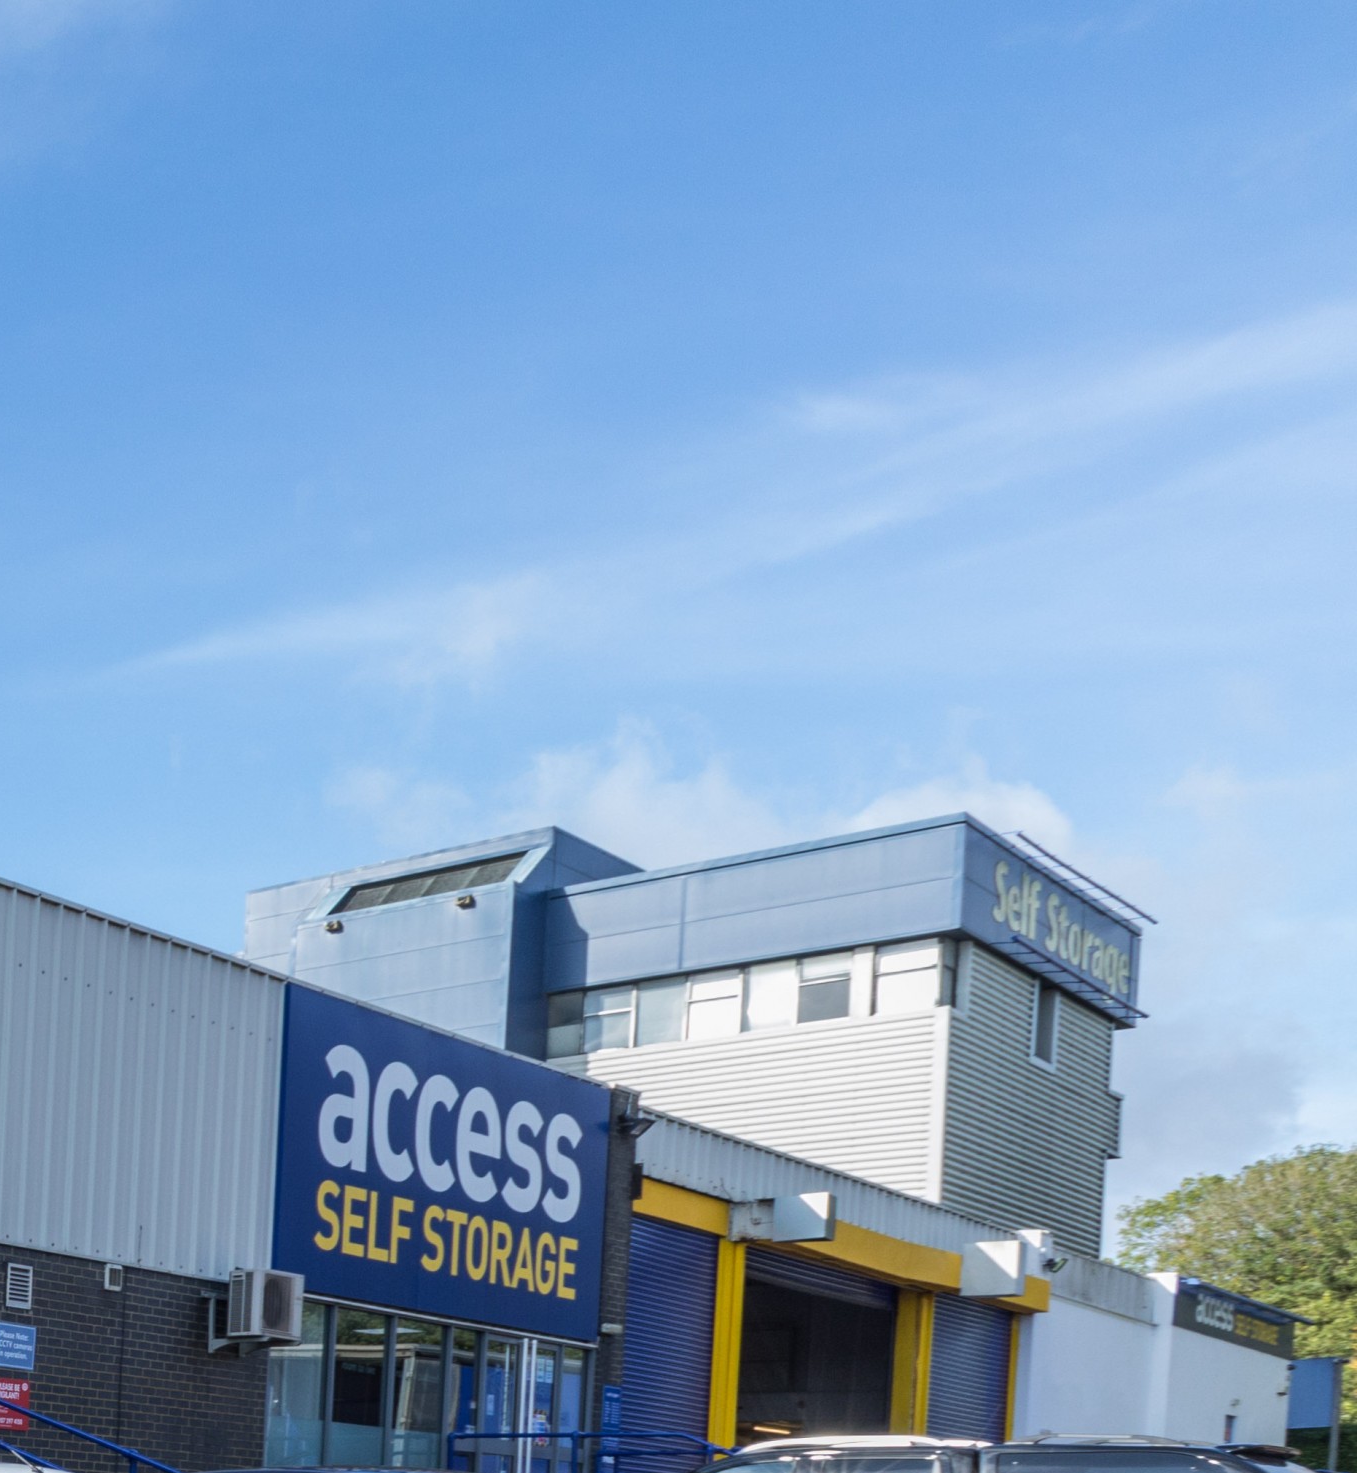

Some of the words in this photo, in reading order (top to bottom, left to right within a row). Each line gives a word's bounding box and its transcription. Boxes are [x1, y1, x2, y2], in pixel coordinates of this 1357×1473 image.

[992, 861, 1042, 940] Self
[1045, 893, 1130, 1003] Storage
[318, 1044, 583, 1222] access
[314, 1180, 414, 1264] SELF
[420, 1205, 578, 1300] STORAGE
[0, 1329, 15, 1339] Please
[14, 1383, 20, 1392] BE
